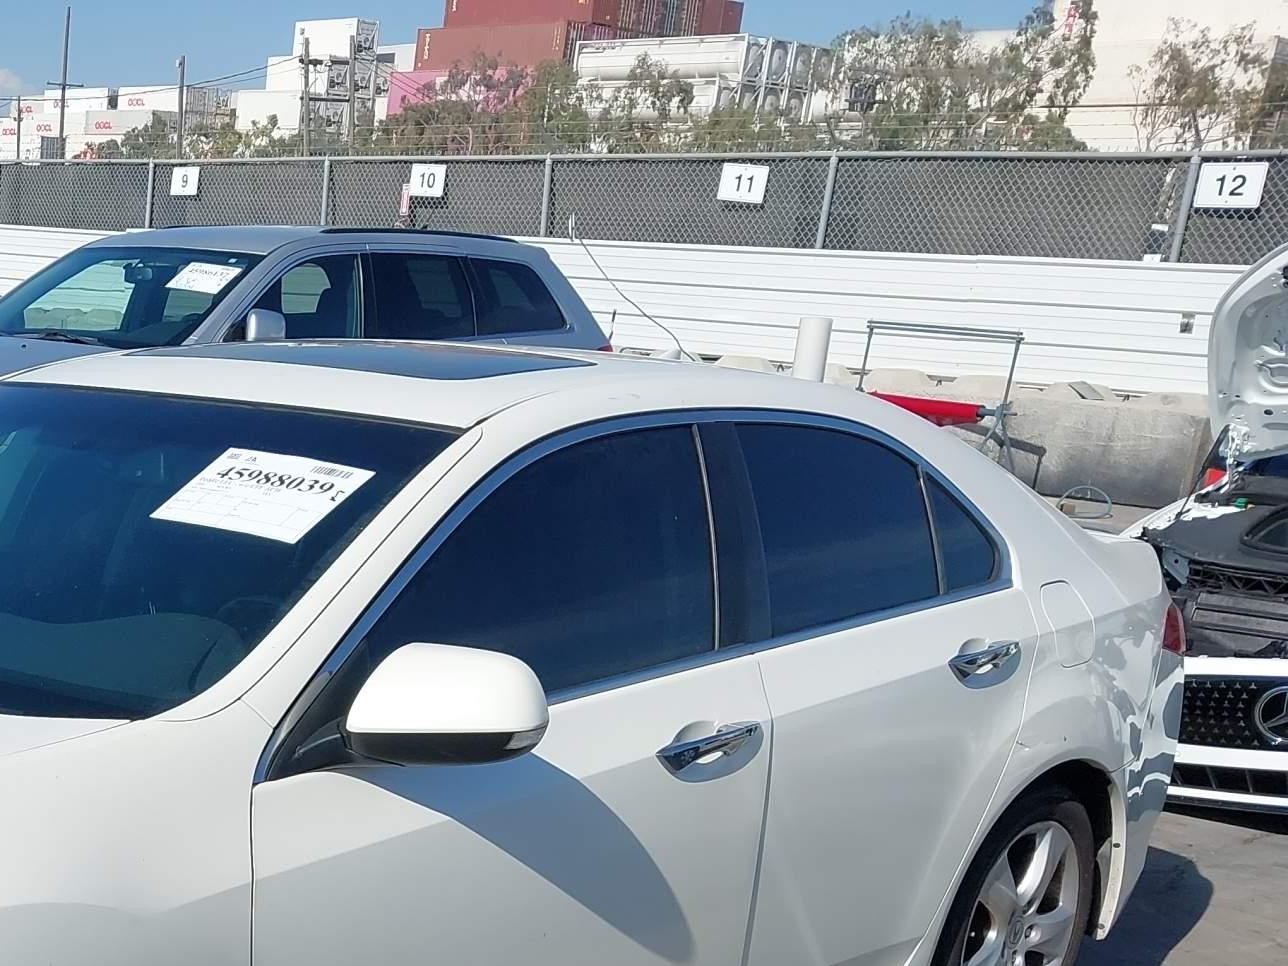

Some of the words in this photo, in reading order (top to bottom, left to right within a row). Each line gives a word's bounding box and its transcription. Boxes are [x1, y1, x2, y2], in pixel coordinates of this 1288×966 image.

[181, 174, 188, 188] 9
[420, 172, 436, 189] 10
[735, 174, 755, 193] 11
[1216, 174, 1247, 197] 12
[216, 466, 335, 494] 45988039
